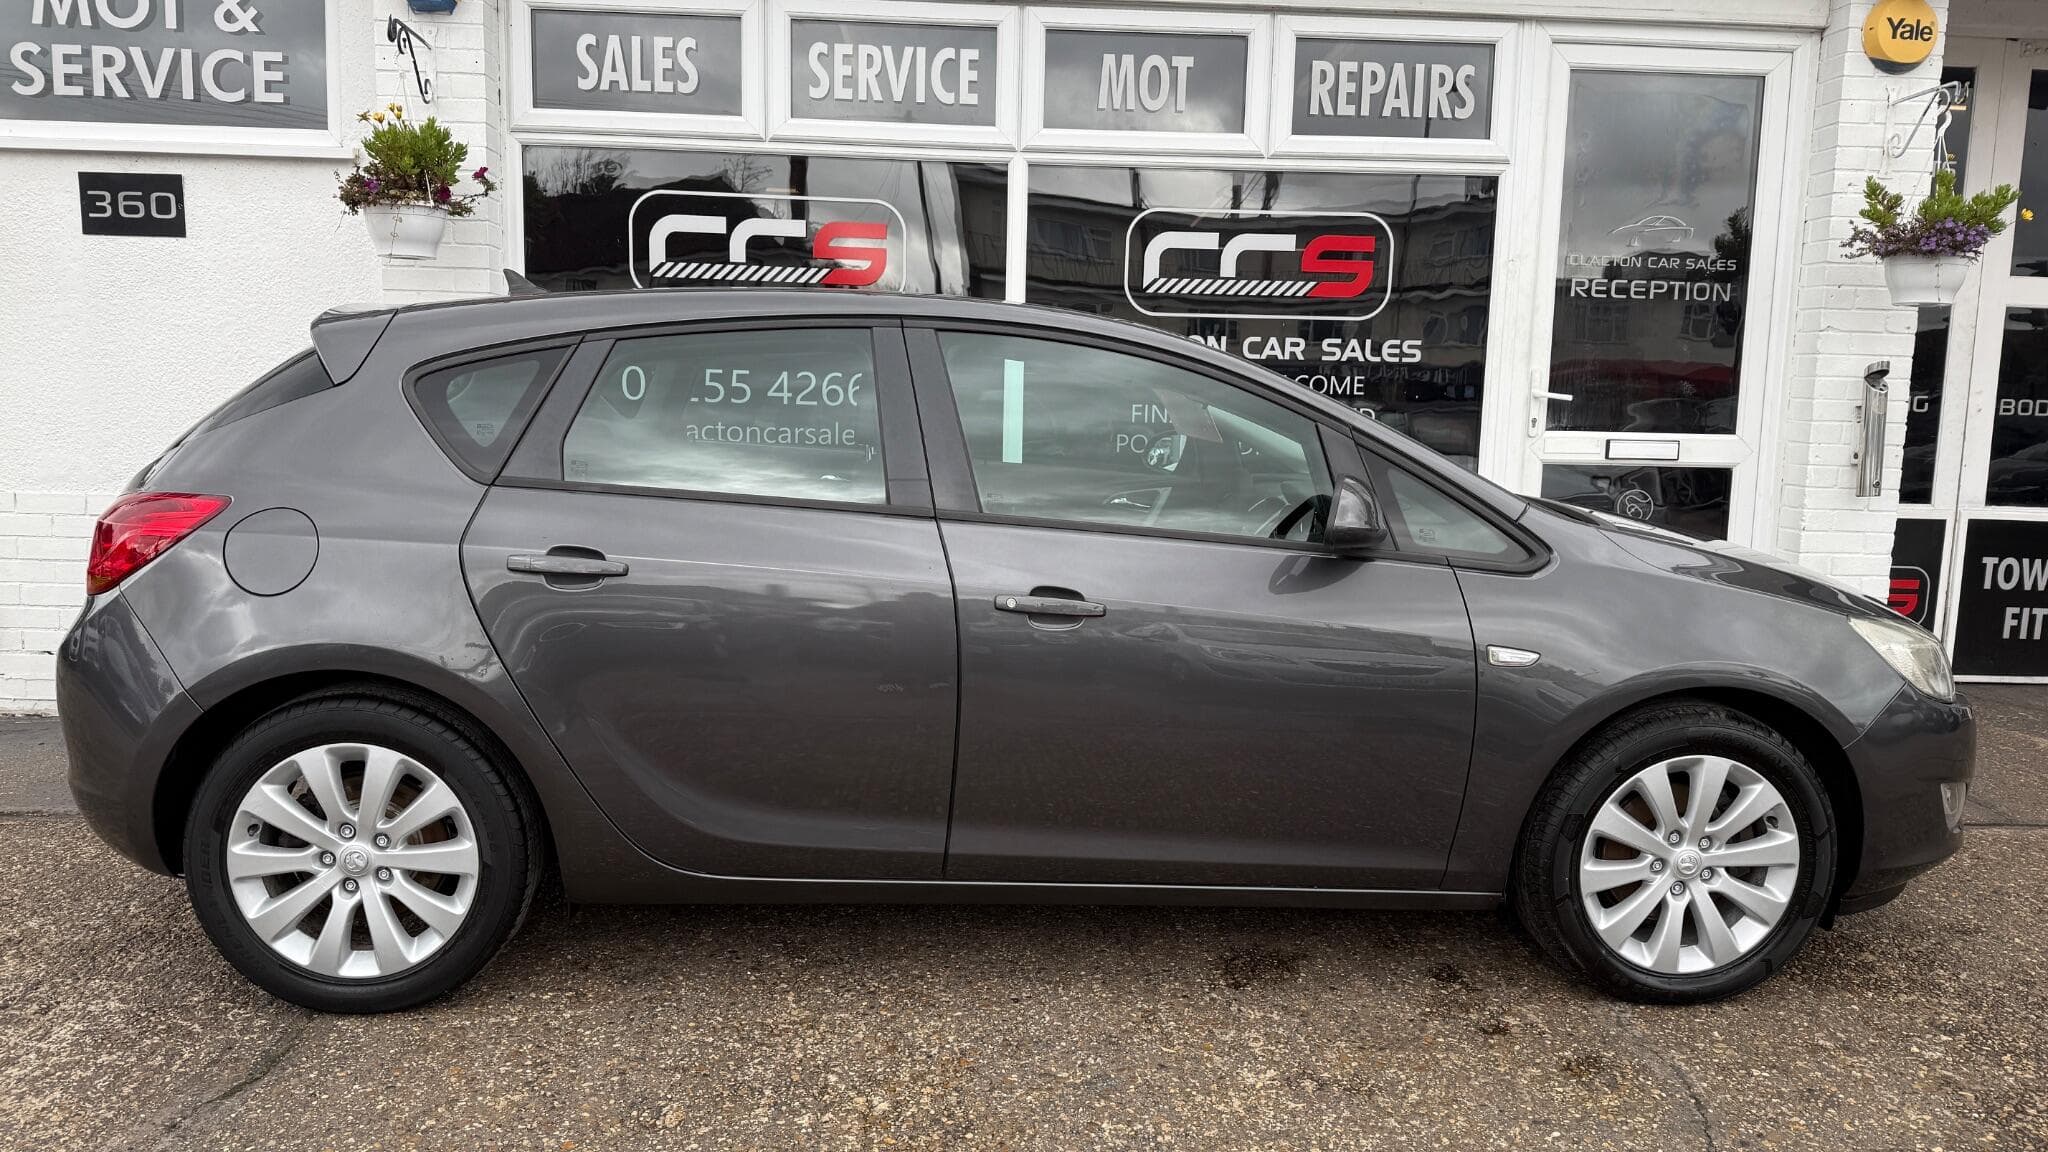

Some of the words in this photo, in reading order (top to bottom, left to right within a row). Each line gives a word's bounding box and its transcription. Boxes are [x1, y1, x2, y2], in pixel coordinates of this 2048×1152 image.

[1886, 17, 1934, 42] Yale
[10, 41, 285, 104] SERVICE
[576, 33, 700, 94] SALES
[808, 41, 980, 105] SERVICE
[1097, 53, 1194, 112] MOT
[1310, 60, 1476, 120] REPAIRS
[87, 190, 177, 219] 360
[1569, 254, 1642, 268] CLACTON
[1647, 257, 1680, 269] CAR
[1685, 258, 1737, 271] SALES
[1570, 278, 1732, 301] RECEPTION
[1242, 336, 1306, 361] CAR
[1321, 338, 1423, 363] SALES
[1131, 403, 1173, 424] FIN
[2002, 606, 2048, 640] FIT
